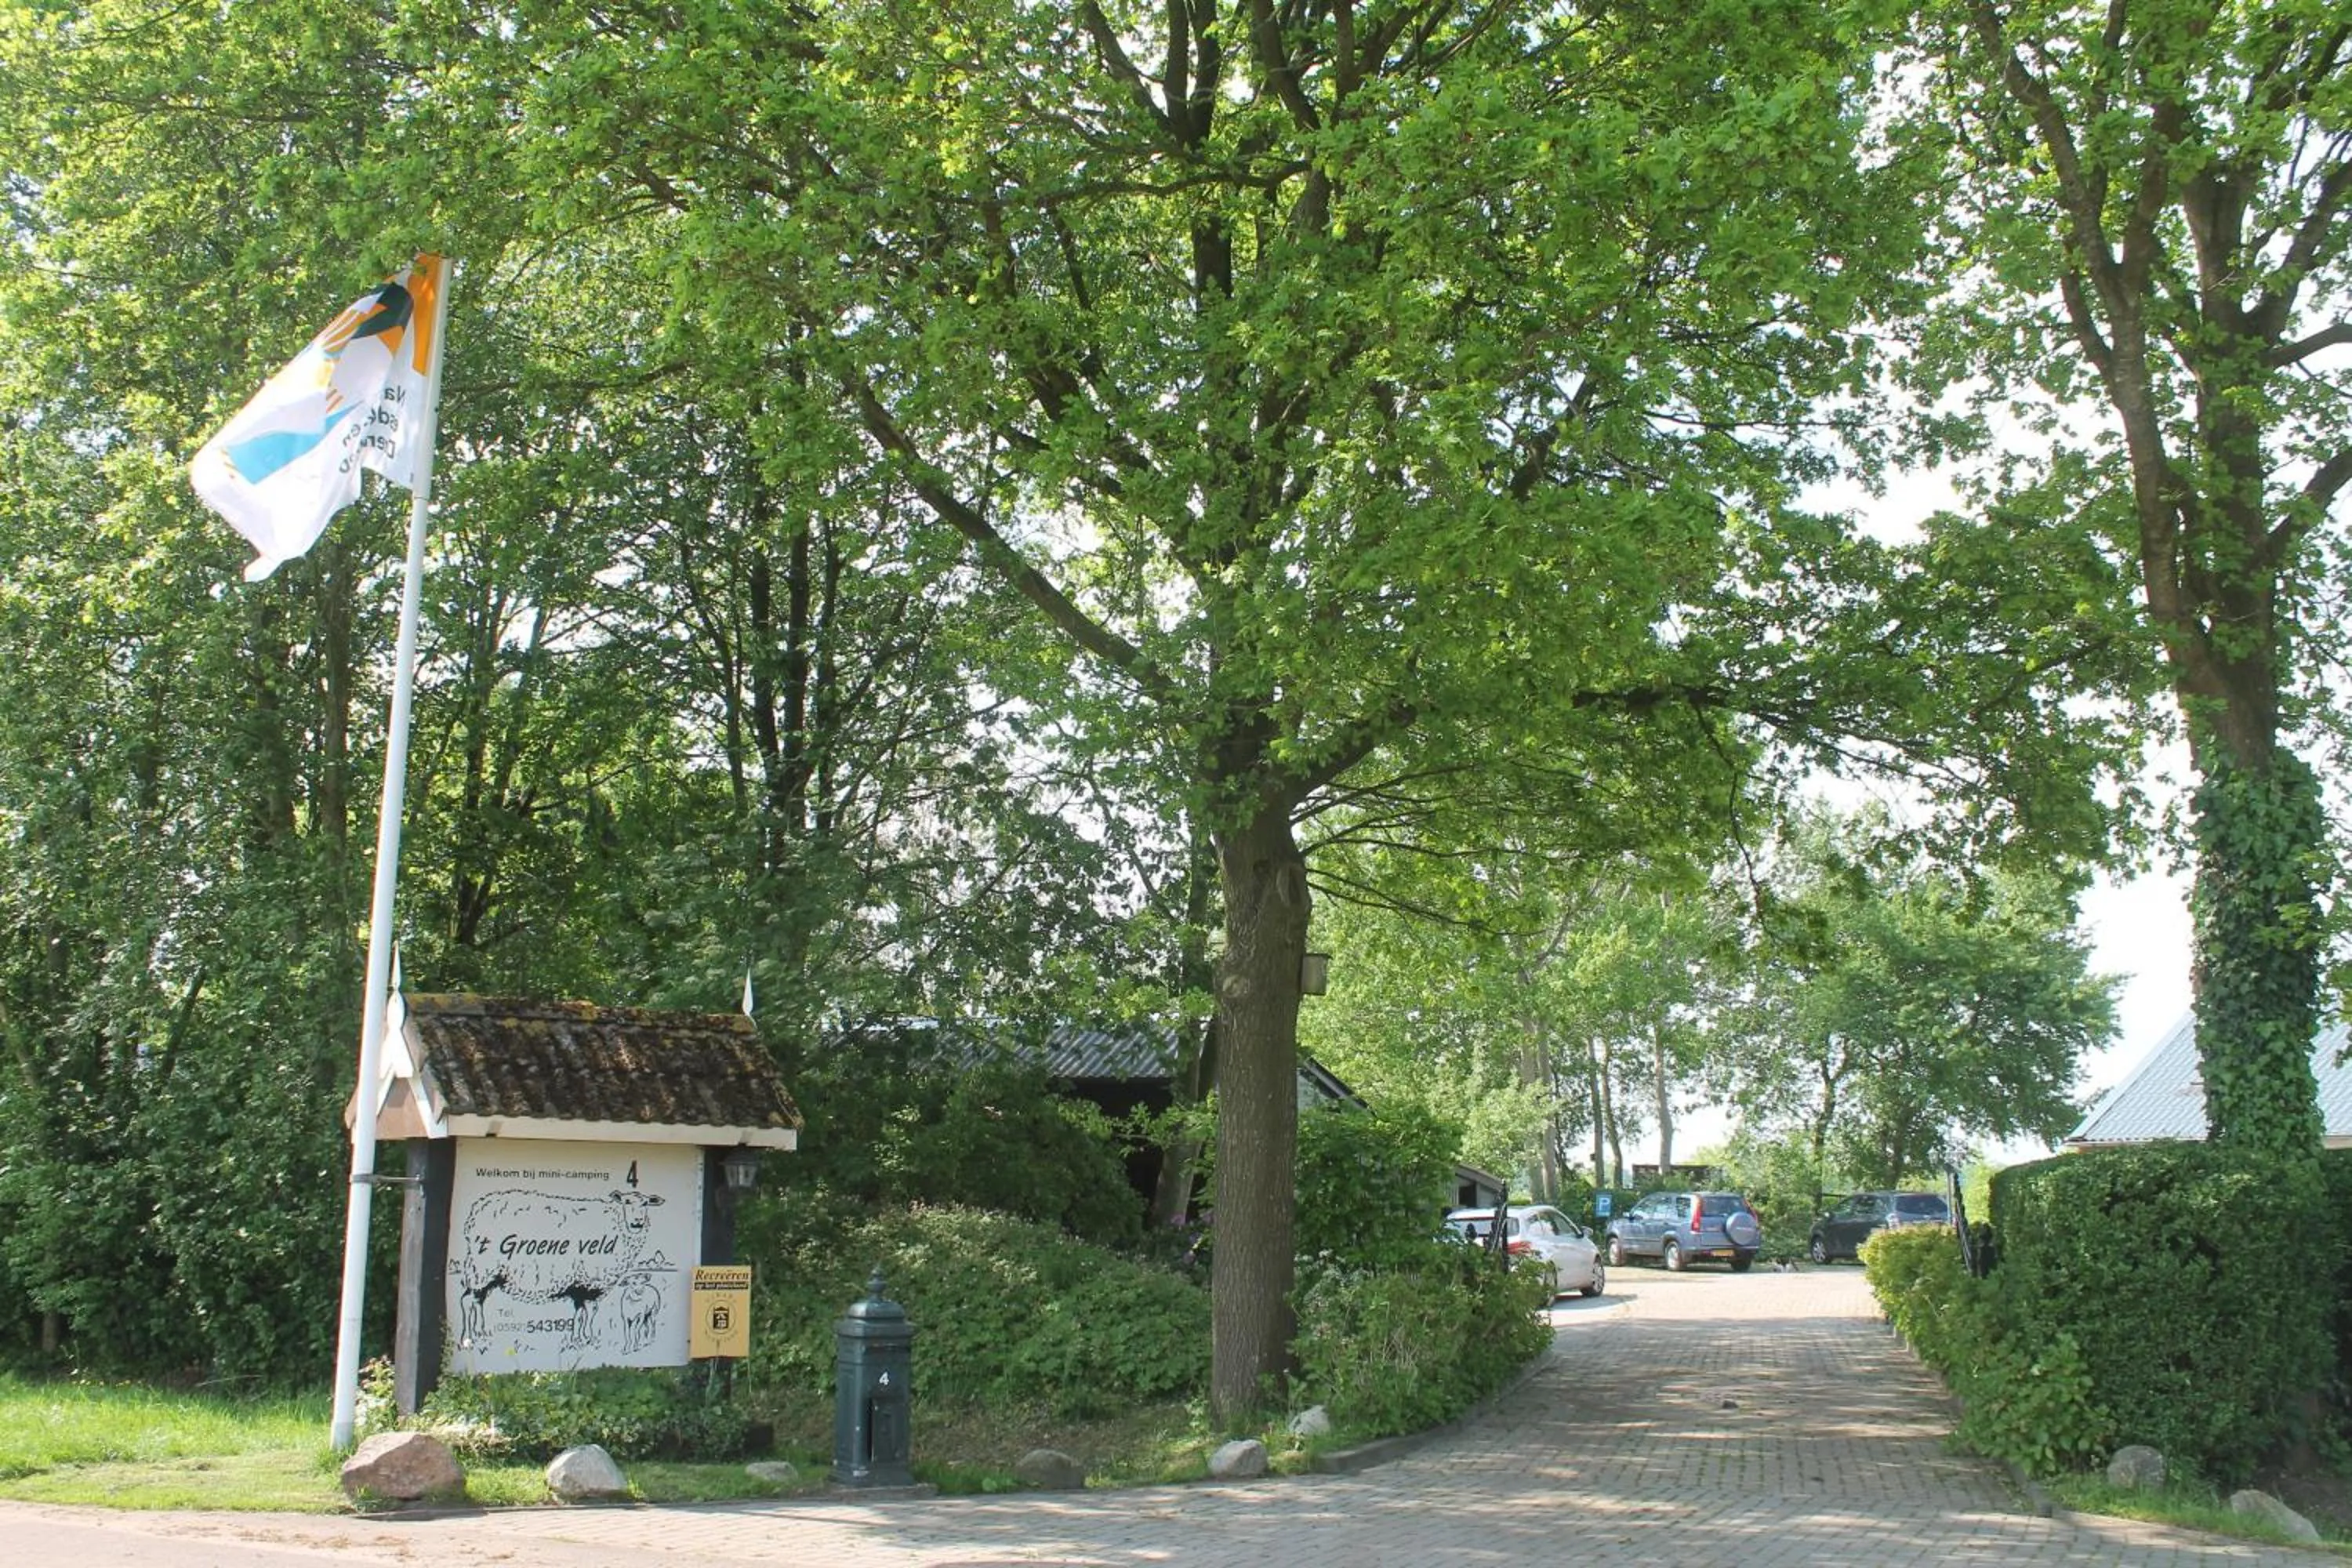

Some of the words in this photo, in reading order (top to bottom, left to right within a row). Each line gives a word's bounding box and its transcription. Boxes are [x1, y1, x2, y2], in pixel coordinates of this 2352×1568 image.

[476, 1167, 520, 1178] Welkom
[523, 1170, 535, 1179] bij
[539, 1169, 609, 1181] mini-camping
[626, 1160, 638, 1188] 4
[1599, 1197, 1610, 1211] P
[474, 1235, 490, 1254] 't
[499, 1234, 569, 1260] Groene
[579, 1234, 618, 1254] veld
[695, 1269, 749, 1280] Recreëren
[879, 1371, 890, 1385] 4
